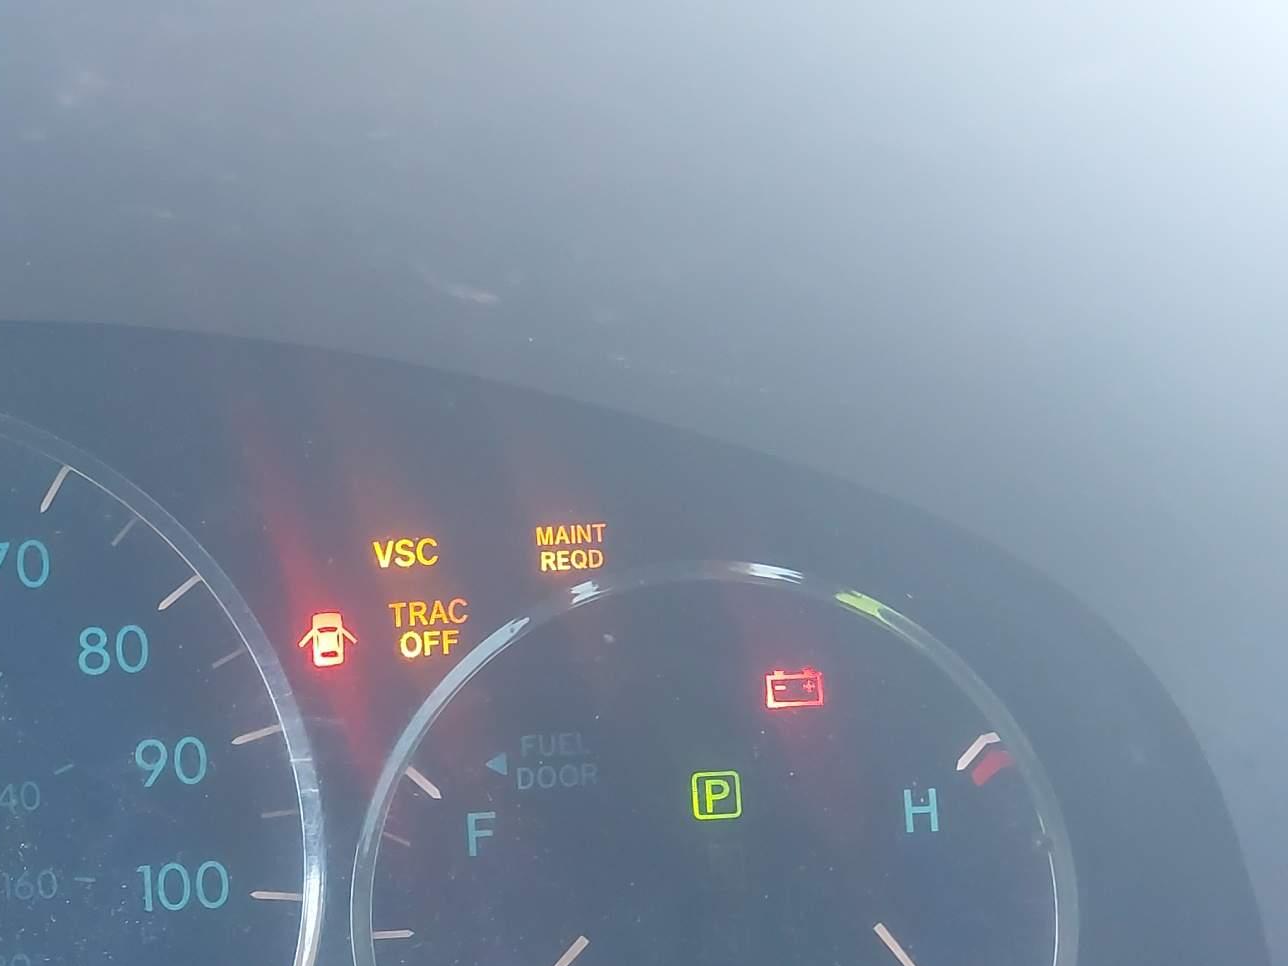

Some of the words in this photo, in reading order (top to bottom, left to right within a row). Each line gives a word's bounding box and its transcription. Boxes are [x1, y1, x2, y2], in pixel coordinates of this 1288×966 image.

[535, 523, 606, 546] MAINT
[372, 537, 439, 568] VSC
[540, 549, 604, 572] REQD
[388, 599, 468, 628] TRAC
[76, 624, 150, 676] 80
[400, 630, 459, 658] OFF
[520, 731, 587, 758] FUEL
[134, 735, 208, 788] 90
[516, 762, 599, 791] DOOR
[903, 787, 940, 833] H
[466, 811, 497, 857] F
[4, 867, 59, 902] 160
[137, 861, 230, 912] 100
